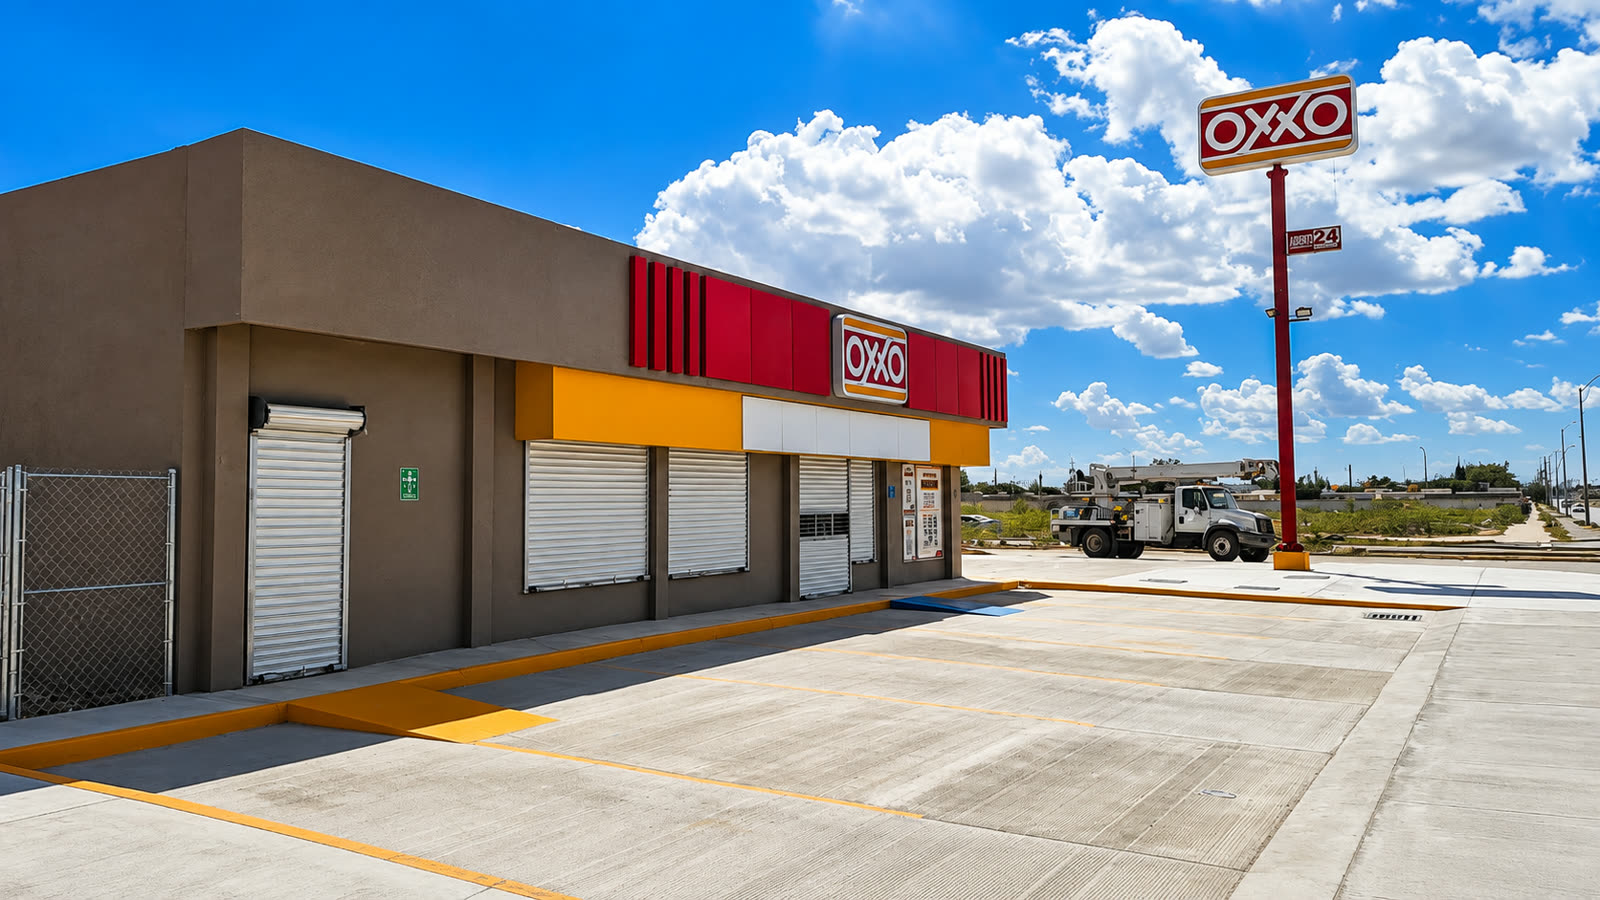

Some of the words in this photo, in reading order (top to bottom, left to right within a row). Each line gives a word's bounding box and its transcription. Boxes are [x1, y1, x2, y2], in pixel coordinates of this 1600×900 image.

[1205, 92, 1347, 154] OXXO
[1314, 228, 1338, 244] 24
[846, 335, 904, 384] OXXO
